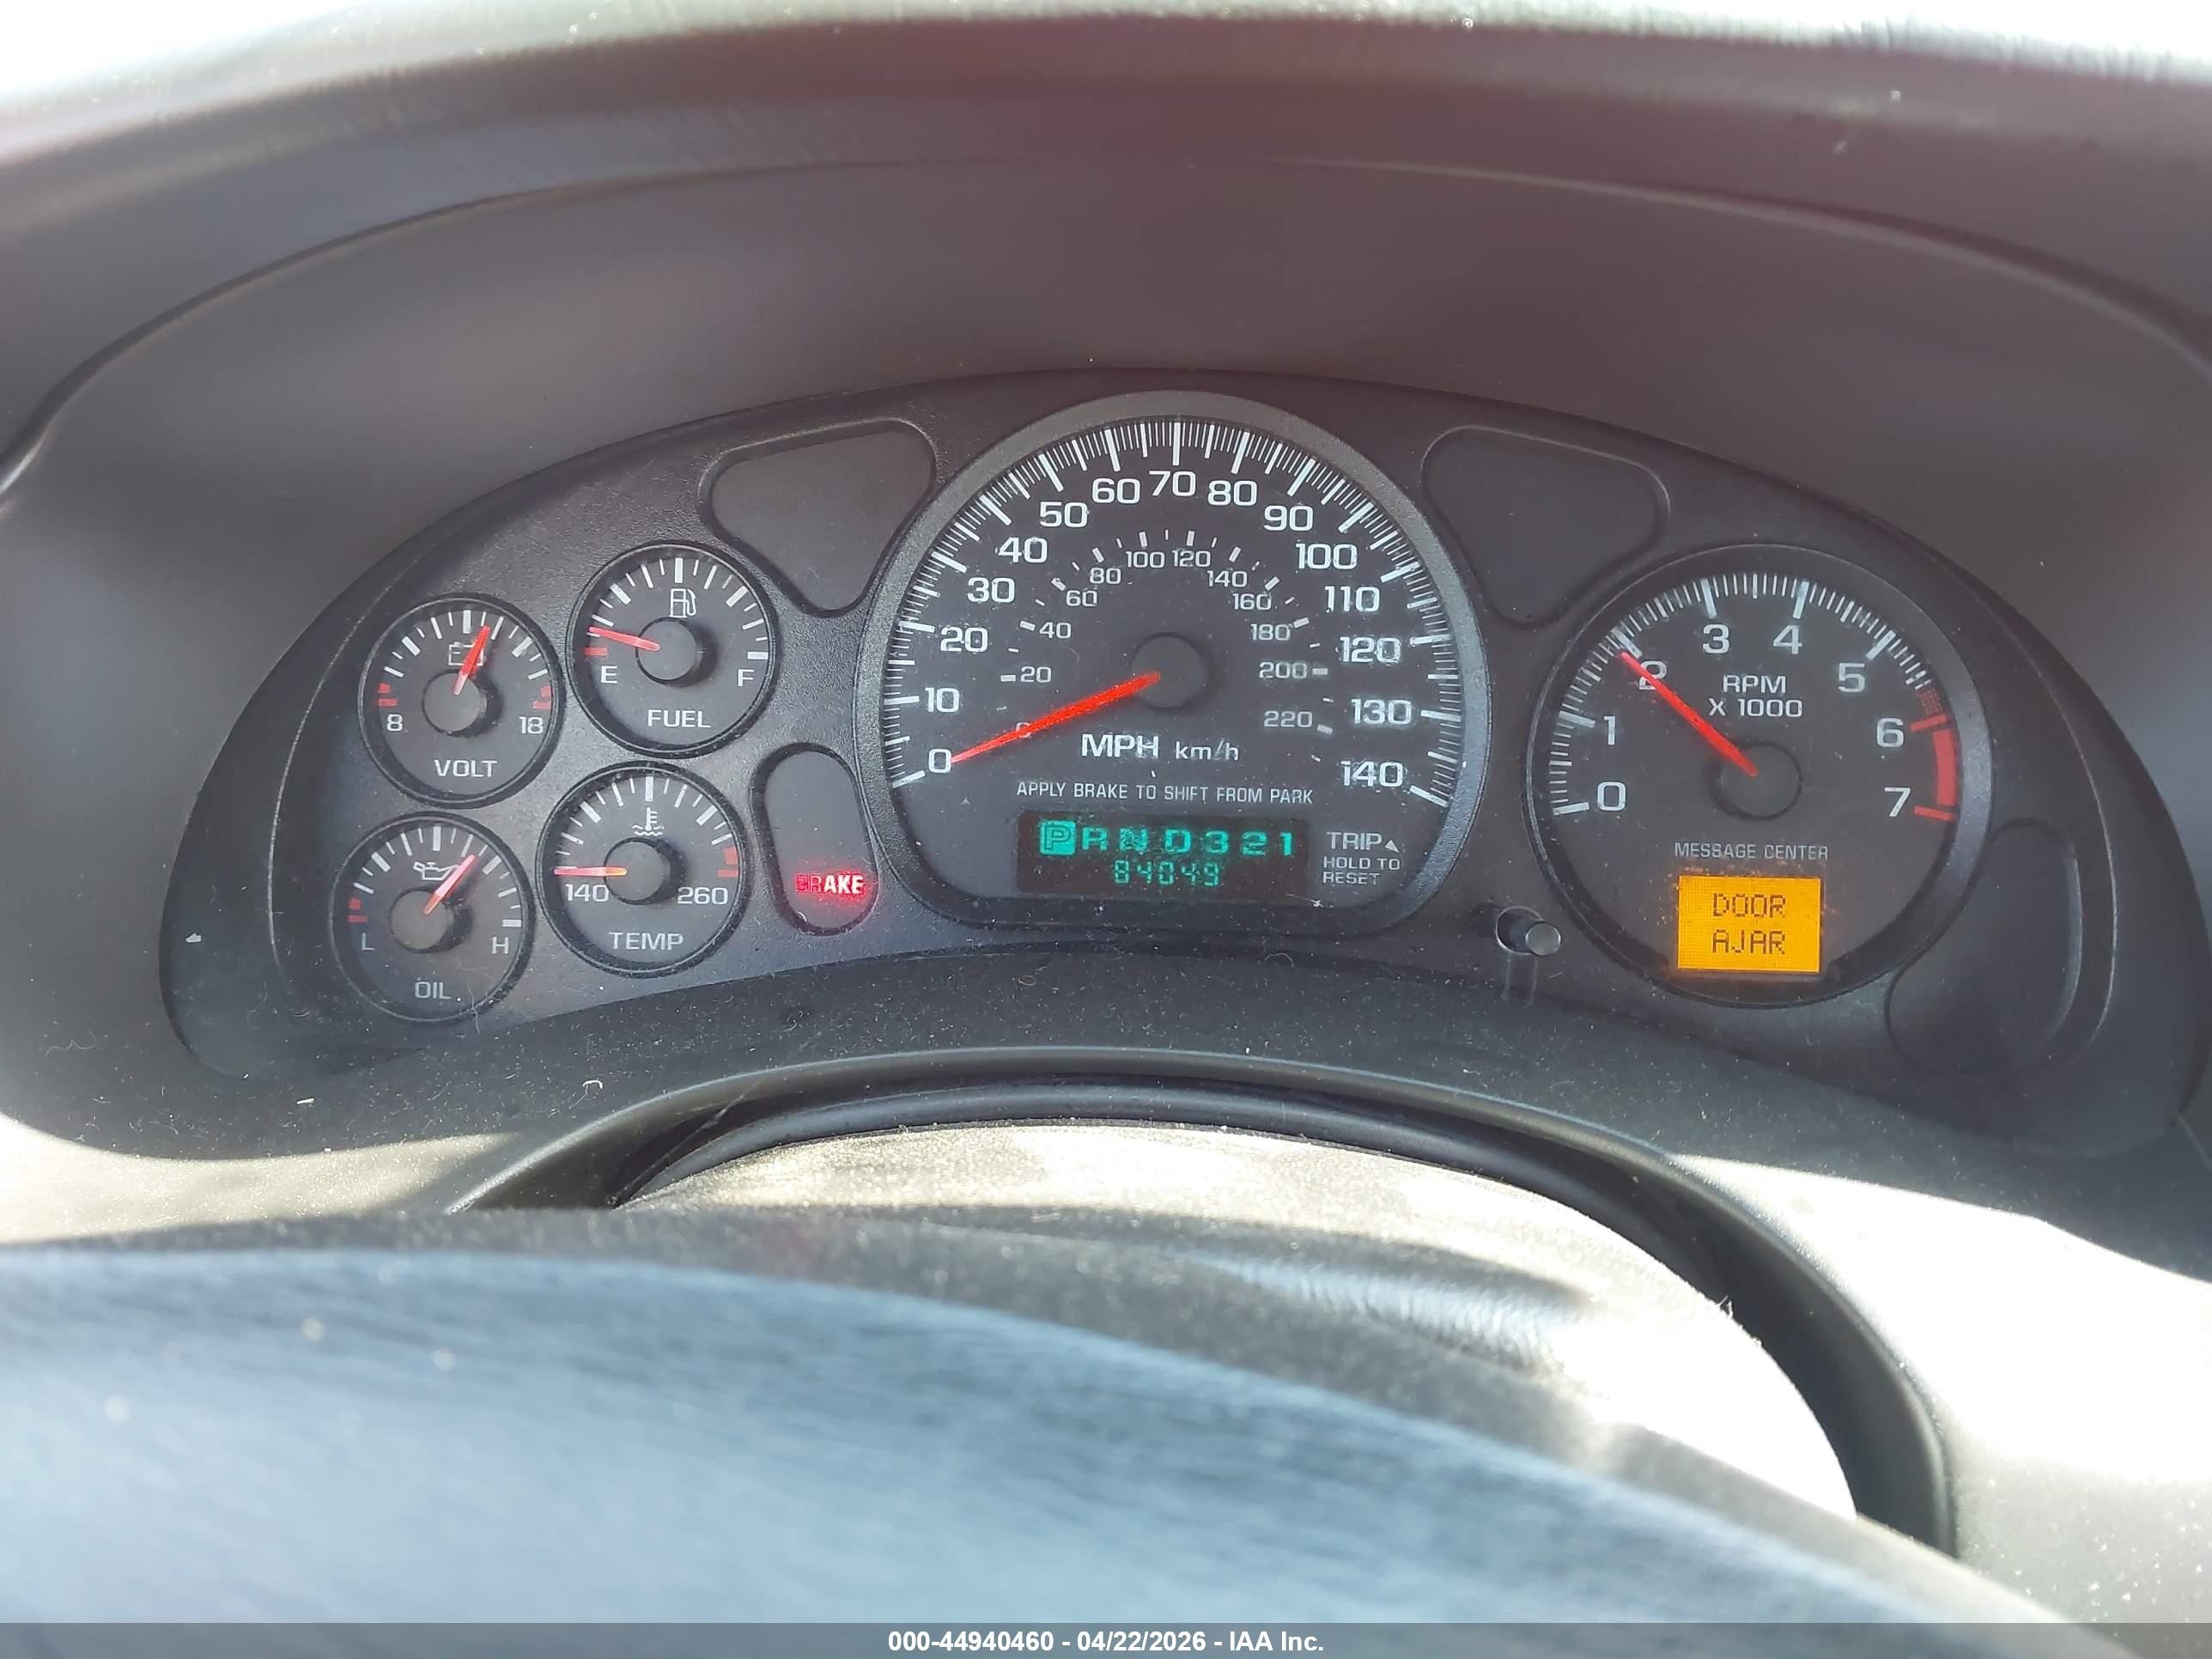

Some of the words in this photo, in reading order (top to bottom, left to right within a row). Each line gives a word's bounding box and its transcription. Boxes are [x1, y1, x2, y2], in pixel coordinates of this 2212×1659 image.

[1091, 478, 1140, 504] 60
[1149, 471, 1196, 496] 70
[1207, 480, 1257, 506] 80
[1039, 501, 1088, 527] 50
[1264, 505, 1314, 532] 90
[998, 538, 1048, 563] 40
[1126, 551, 1165, 568] 100
[1172, 550, 1212, 568] 120
[1296, 544, 1358, 570] 100
[1090, 568, 1121, 585] 80
[1206, 570, 1248, 587] 140
[967, 577, 1015, 603] 30
[1066, 590, 1098, 607] 60
[1325, 586, 1380, 612] 110
[1232, 593, 1272, 611] 160
[940, 627, 988, 653] 20
[1039, 622, 1072, 639] 40
[1250, 623, 1291, 641] 180
[1702, 624, 1729, 653] 3
[1773, 625, 1802, 654] 4
[1340, 636, 1401, 664] 120
[601, 666, 617, 684] E
[738, 669, 755, 687] F
[1020, 666, 1052, 683] 20
[1259, 662, 1307, 678] 200
[1838, 663, 1866, 692] 5
[1723, 676, 1786, 694] RPM
[924, 687, 960, 713] 10
[1709, 698, 1726, 716] X
[1738, 699, 1802, 717] 1000
[647, 709, 711, 728] FUEL
[1264, 711, 1313, 727] 220
[1351, 699, 1413, 725] 130
[387, 714, 403, 732] 8
[520, 716, 544, 734] 18
[1603, 716, 1616, 744] 1
[1876, 718, 1904, 747] 6
[1081, 733, 1158, 758] MPH
[1176, 739, 1239, 761] km/h
[434, 759, 497, 778] VOLT
[928, 748, 951, 773] 0
[1340, 761, 1404, 787] 140
[1017, 781, 1066, 798] APPLY
[1074, 783, 1127, 799] BRAKE
[1136, 785, 1157, 799] TO
[1164, 786, 1208, 802] SHIFT
[1217, 787, 1261, 803] FROM
[1270, 788, 1313, 804] PARK
[1596, 782, 1626, 811] 0
[1885, 787, 1911, 817] 7
[1165, 829, 1192, 853] D
[1205, 830, 1229, 854] 3
[1241, 831, 1267, 856] 2
[1279, 832, 1292, 856] 1
[1327, 832, 1382, 850] TRIP
[1674, 842, 1756, 859] MESSAGE
[1765, 844, 1828, 860] CENTER
[1115, 860, 1219, 886] 84049
[1323, 857, 1370, 871] HOLD
[1376, 858, 1401, 871] TO
[1323, 872, 1379, 885] RESET
[565, 884, 610, 902] 140
[678, 887, 728, 905] 260
[1712, 893, 1786, 918] DOOR
[362, 933, 374, 951] L
[492, 937, 509, 954] H
[610, 932, 684, 951] TEMP
[1712, 930, 1786, 955] AJAR
[415, 981, 452, 1000] OIL
